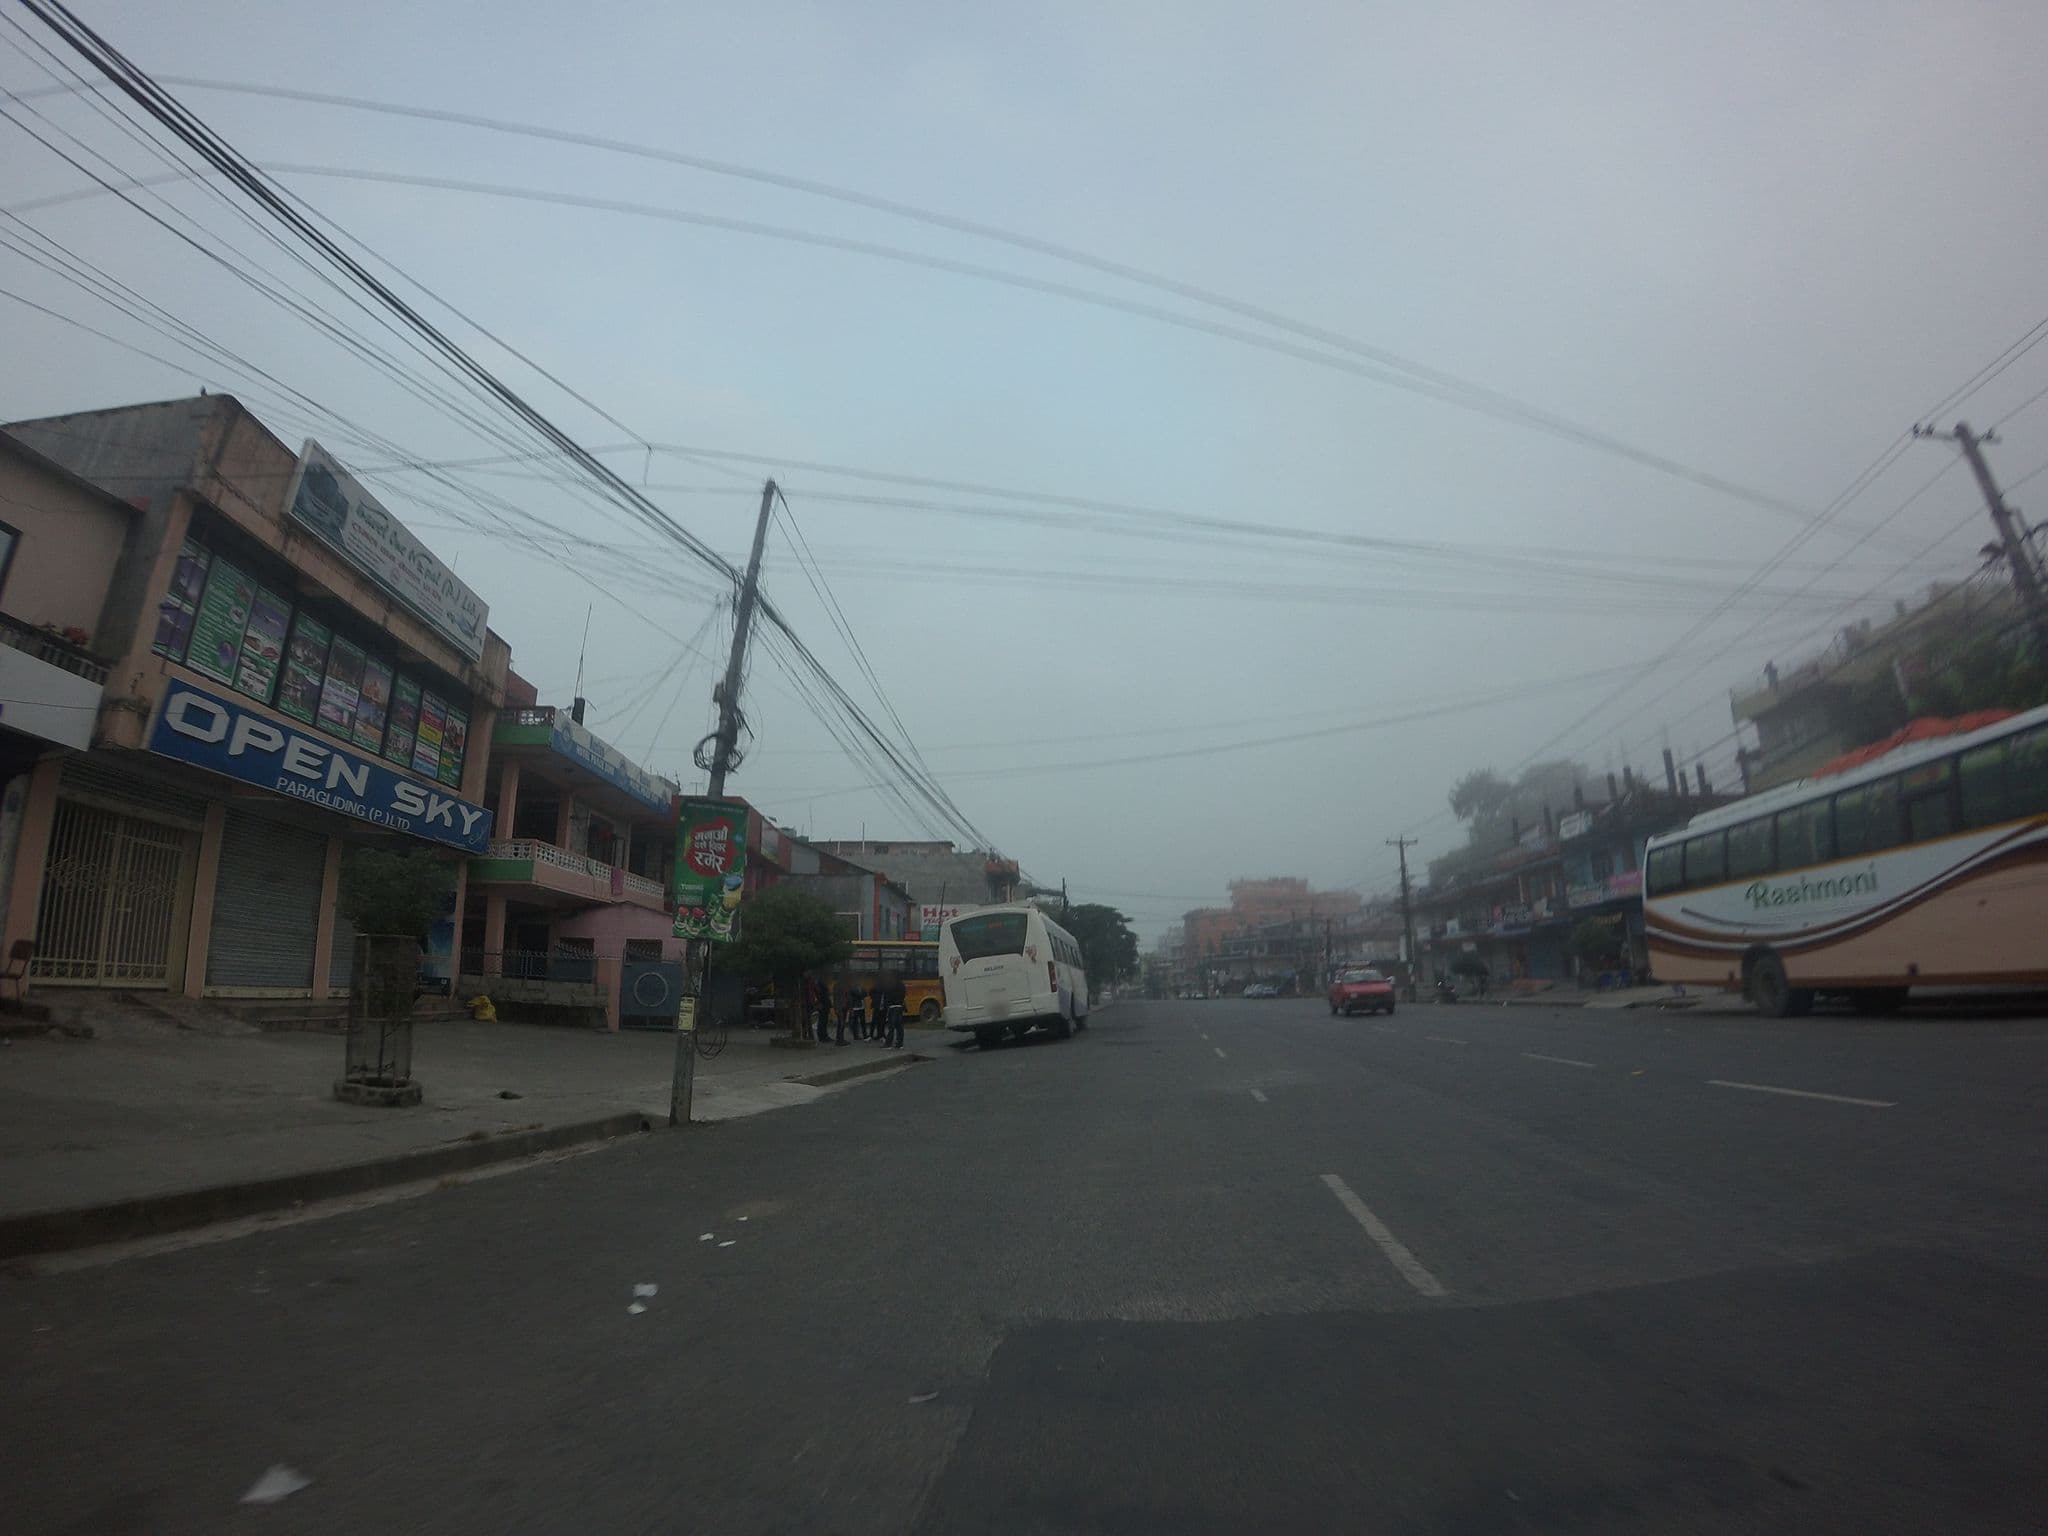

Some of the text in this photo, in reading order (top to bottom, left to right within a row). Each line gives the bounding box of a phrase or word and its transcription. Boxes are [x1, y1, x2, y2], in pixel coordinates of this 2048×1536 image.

[165, 691, 370, 797] OPEN
[390, 781, 483, 836] SKY
[276, 777, 367, 821] PARAGLIDING
